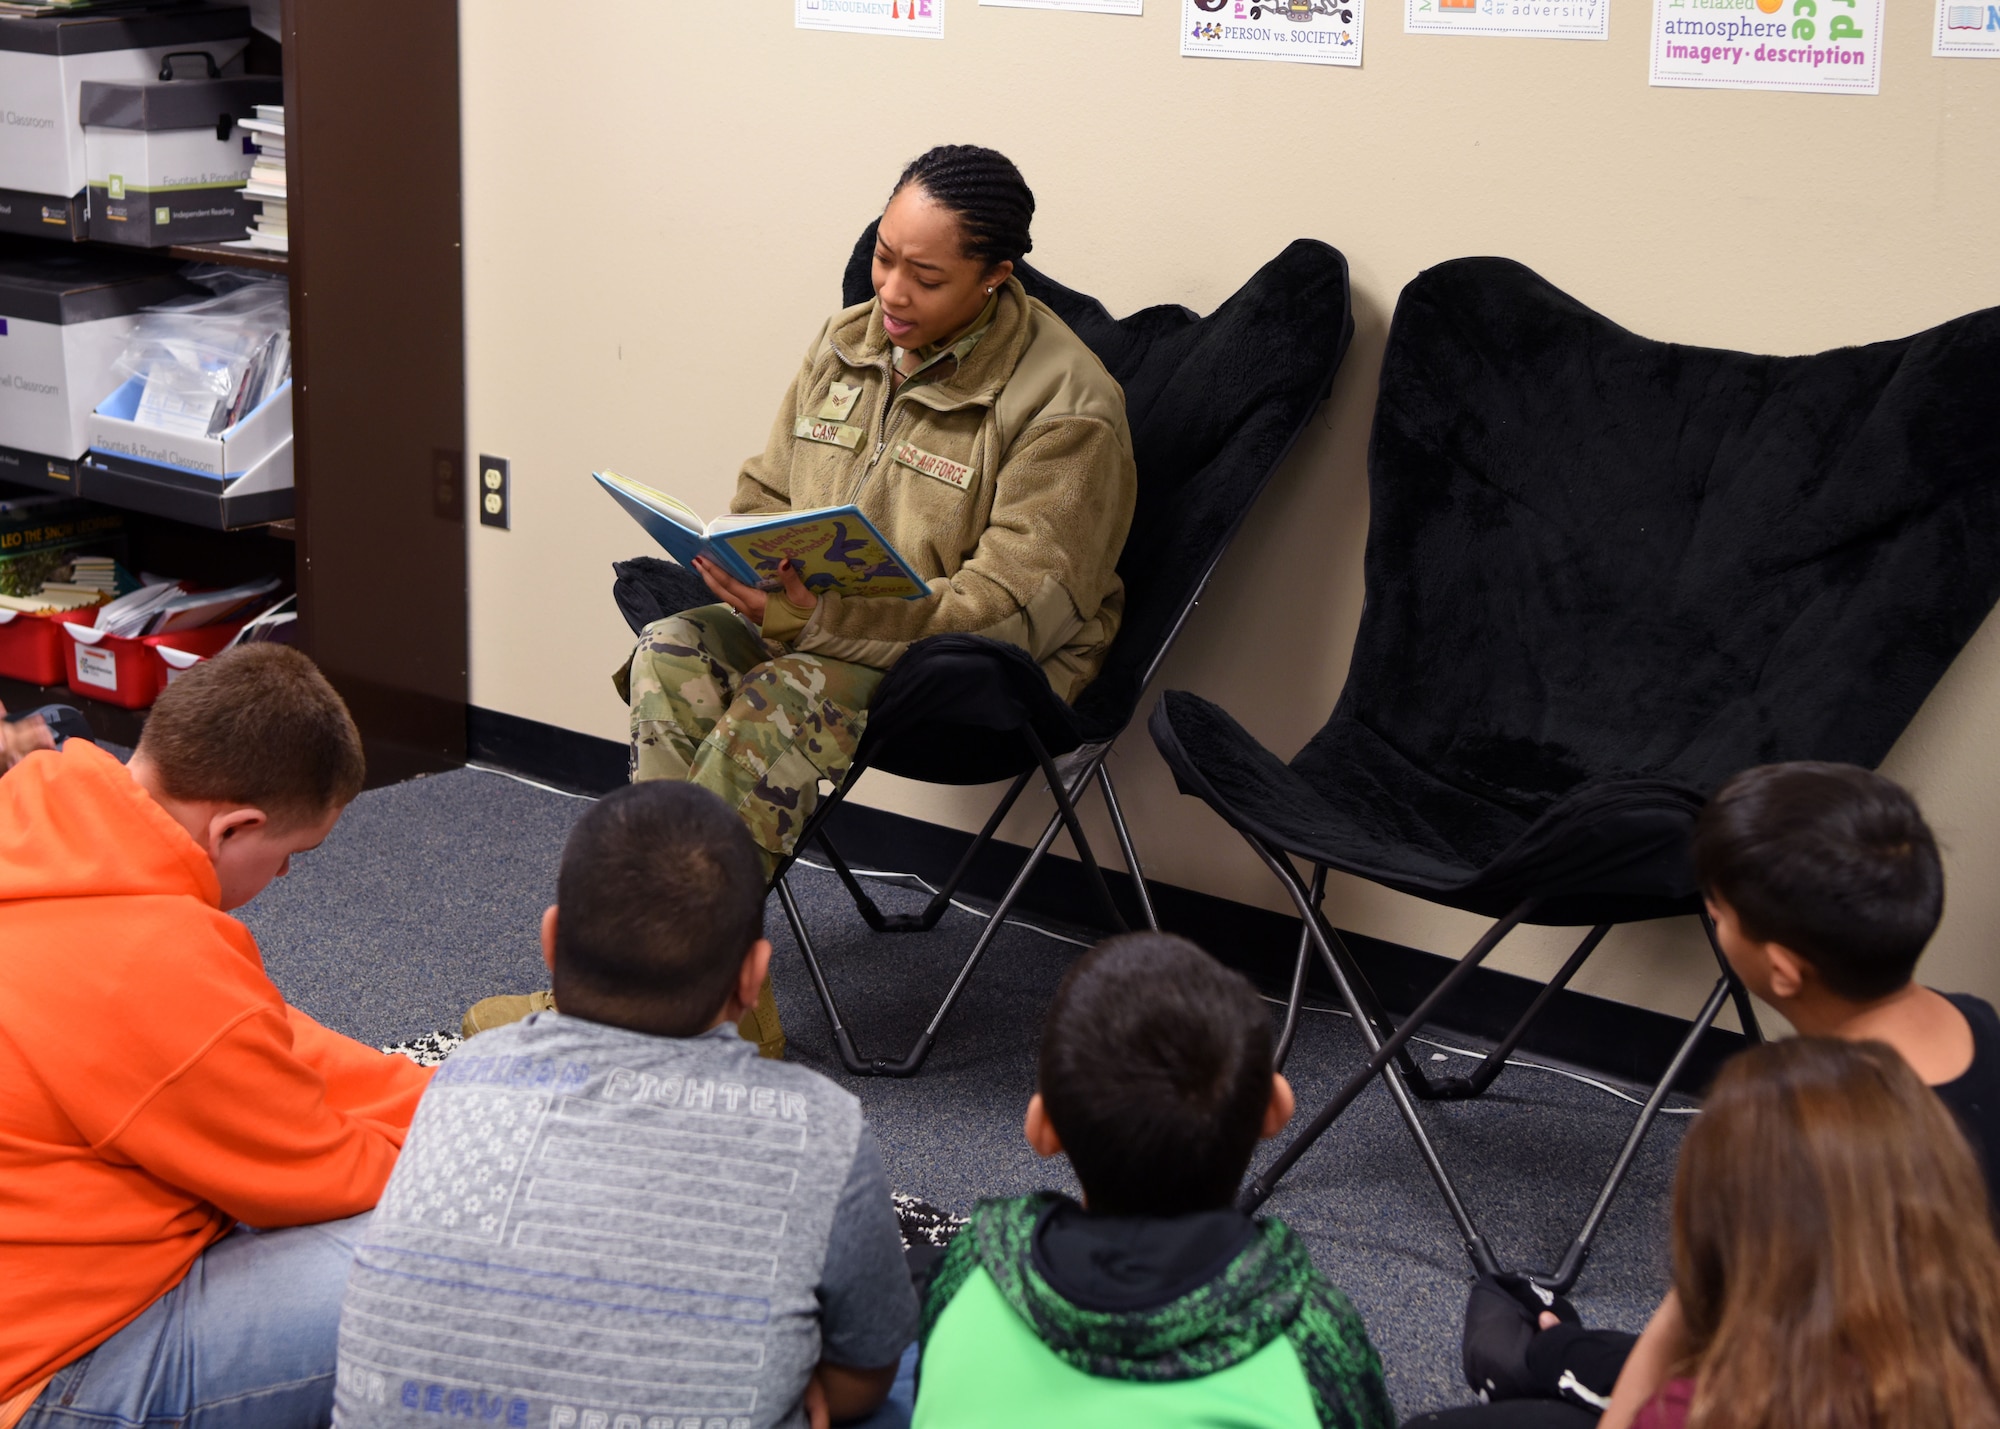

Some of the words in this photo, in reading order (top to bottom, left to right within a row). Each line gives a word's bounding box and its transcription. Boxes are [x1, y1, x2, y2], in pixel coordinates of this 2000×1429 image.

[1511, 4, 1595, 20] adversity
[1224, 26, 1271, 42] PERSON
[1274, 32, 1288, 43] vs.
[1291, 30, 1342, 46] SOCIETY
[1665, 15, 1787, 42] atmosphere
[1666, 40, 1743, 65] imagery
[1754, 44, 1865, 68] description
[7, 110, 55, 129] Classroom
[163, 175, 198, 187] Fountas
[201, 173, 208, 184] &
[210, 171, 238, 183] Pinnell
[173, 208, 210, 220] Independent
[211, 206, 235, 217] Reading
[13, 375, 59, 396] Classroom
[812, 422, 839, 442] CASH
[97, 434, 129, 452] Fountas
[131, 442, 138, 456] &
[140, 445, 168, 462] Pinnell
[169, 451, 216, 473] Classroom
[899, 445, 915, 465] U.S.
[918, 454, 936, 473] AIR
[935, 459, 967, 485] FORCE
[1, 530, 22, 549] LEO
[24, 527, 43, 544] THE
[44, 522, 75, 541] SNOW
[750, 525, 819, 552] Hunches
[779, 532, 834, 558] Bunches
[790, 538, 805, 547] in
[601, 1066, 809, 1123] FIGHTER
[402, 1379, 529, 1429] SERVE
